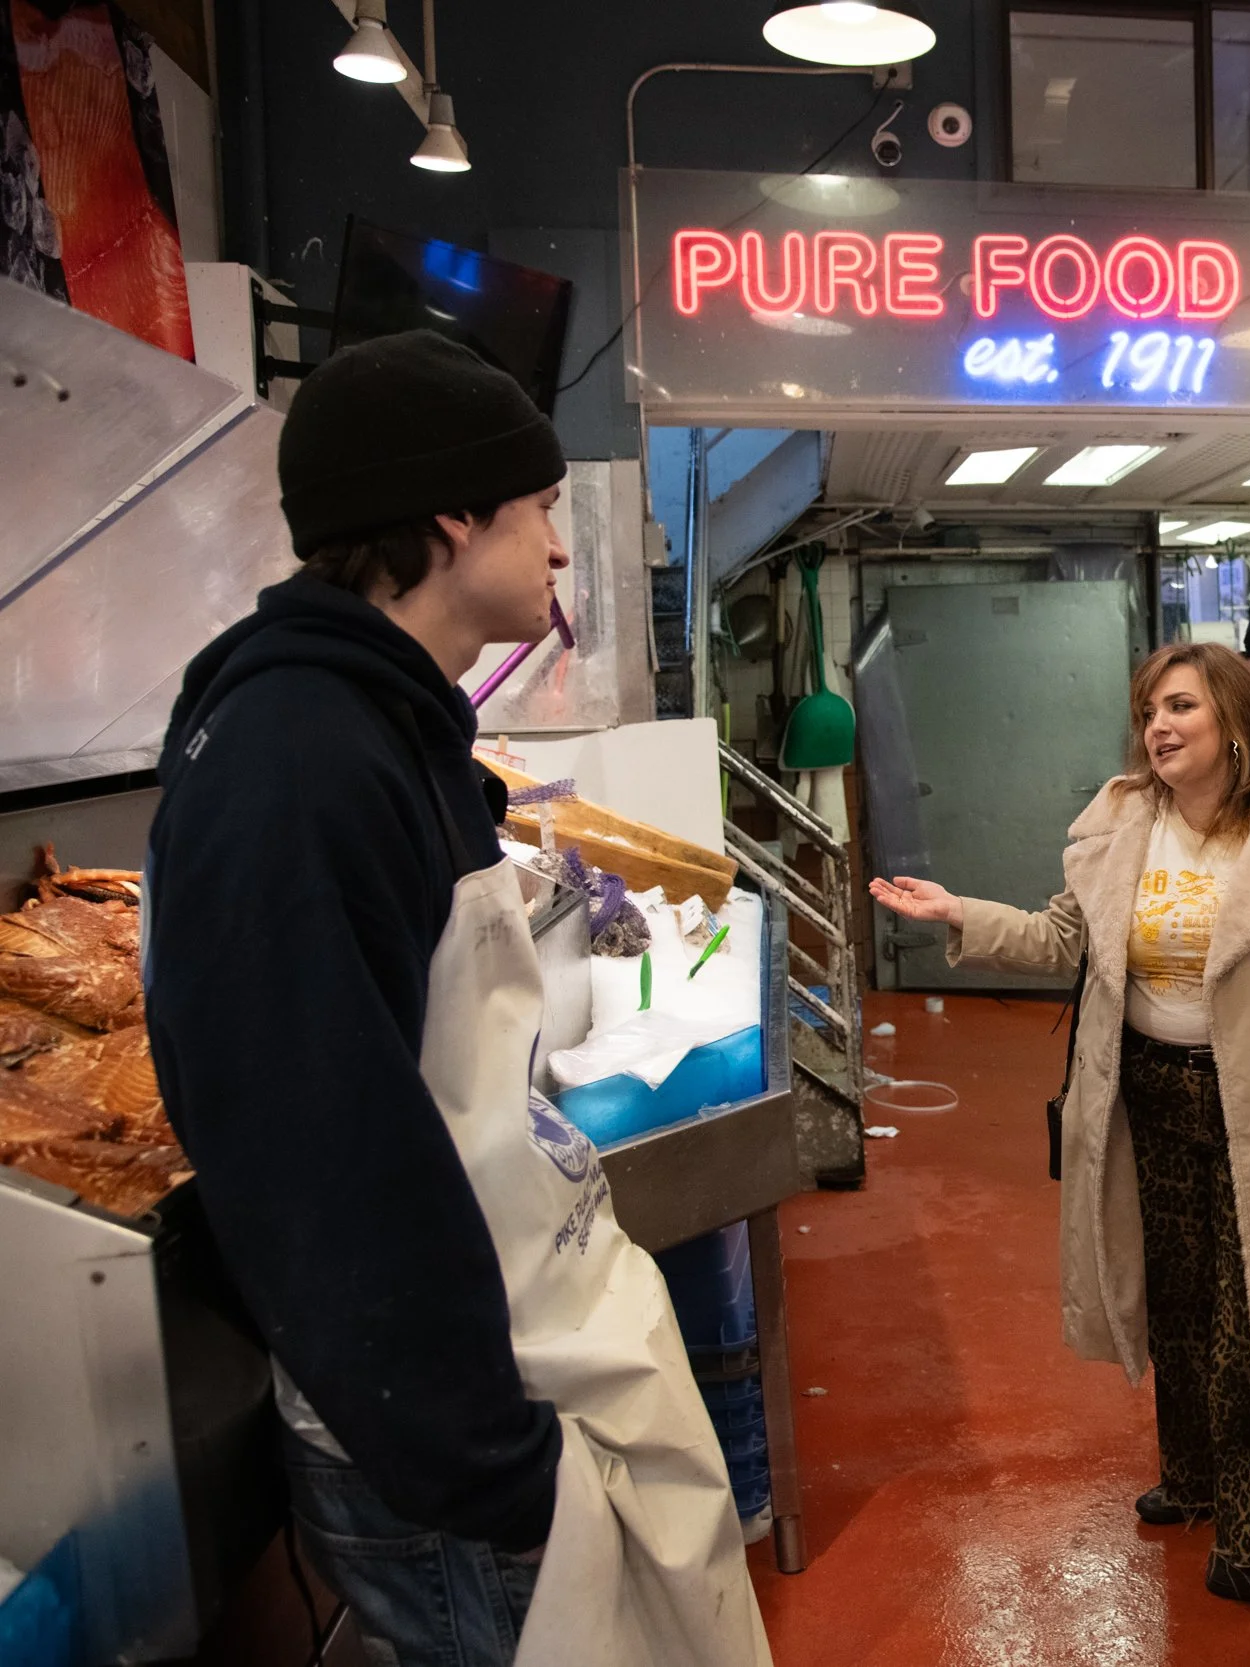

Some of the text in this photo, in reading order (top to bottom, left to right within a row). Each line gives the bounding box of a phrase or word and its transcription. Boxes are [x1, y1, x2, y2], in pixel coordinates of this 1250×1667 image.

[672, 229, 944, 317] PURE
[974, 234, 1239, 320] FOOD
[963, 332, 1216, 394] est. 1911
